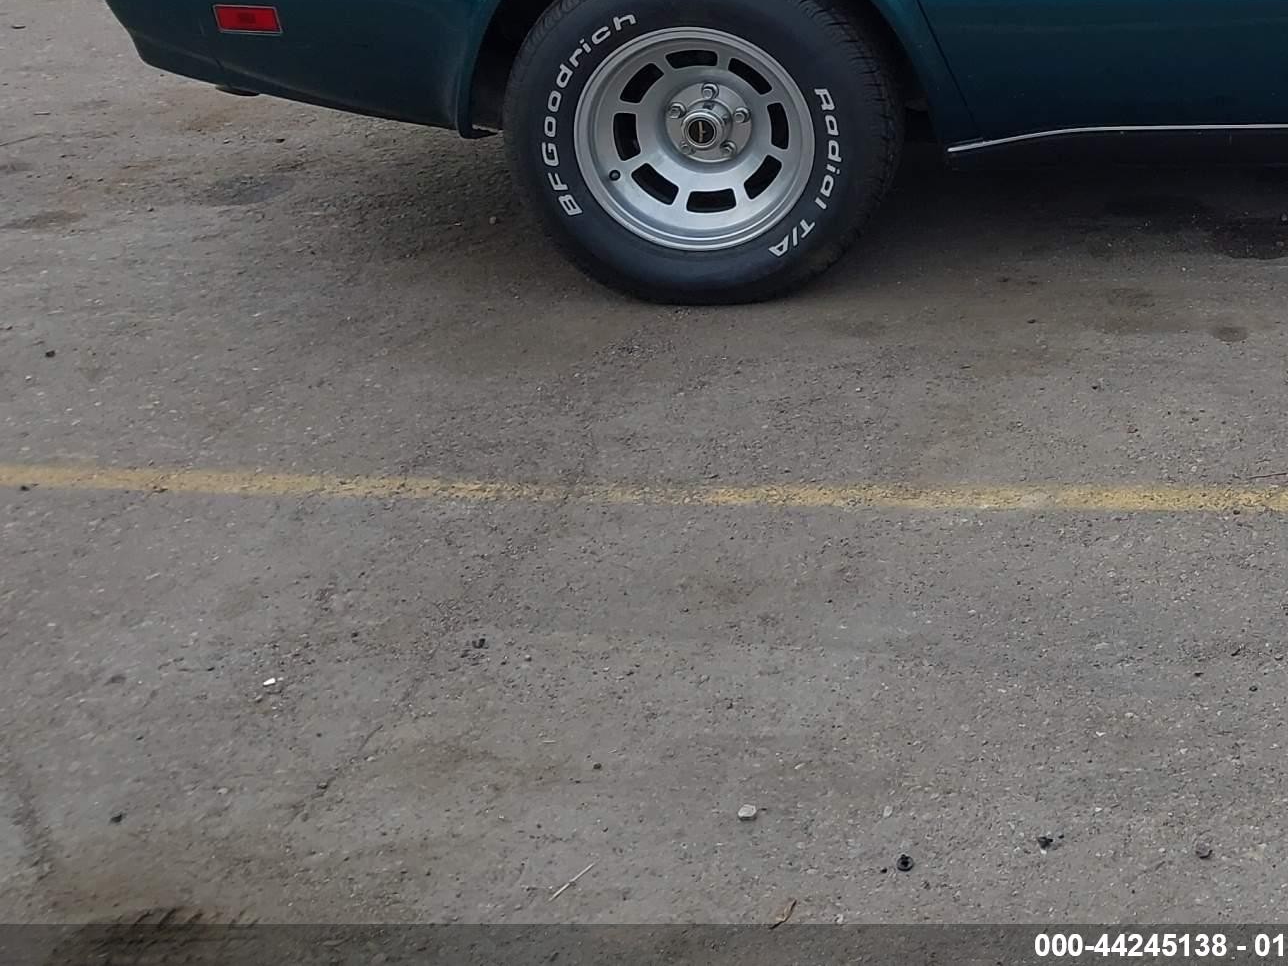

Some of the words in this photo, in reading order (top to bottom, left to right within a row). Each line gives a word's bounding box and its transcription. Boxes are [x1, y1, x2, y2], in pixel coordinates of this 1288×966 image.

[541, 11, 637, 218] BFGoodrich
[813, 87, 843, 211] Radial
[768, 219, 816, 257] T/A
